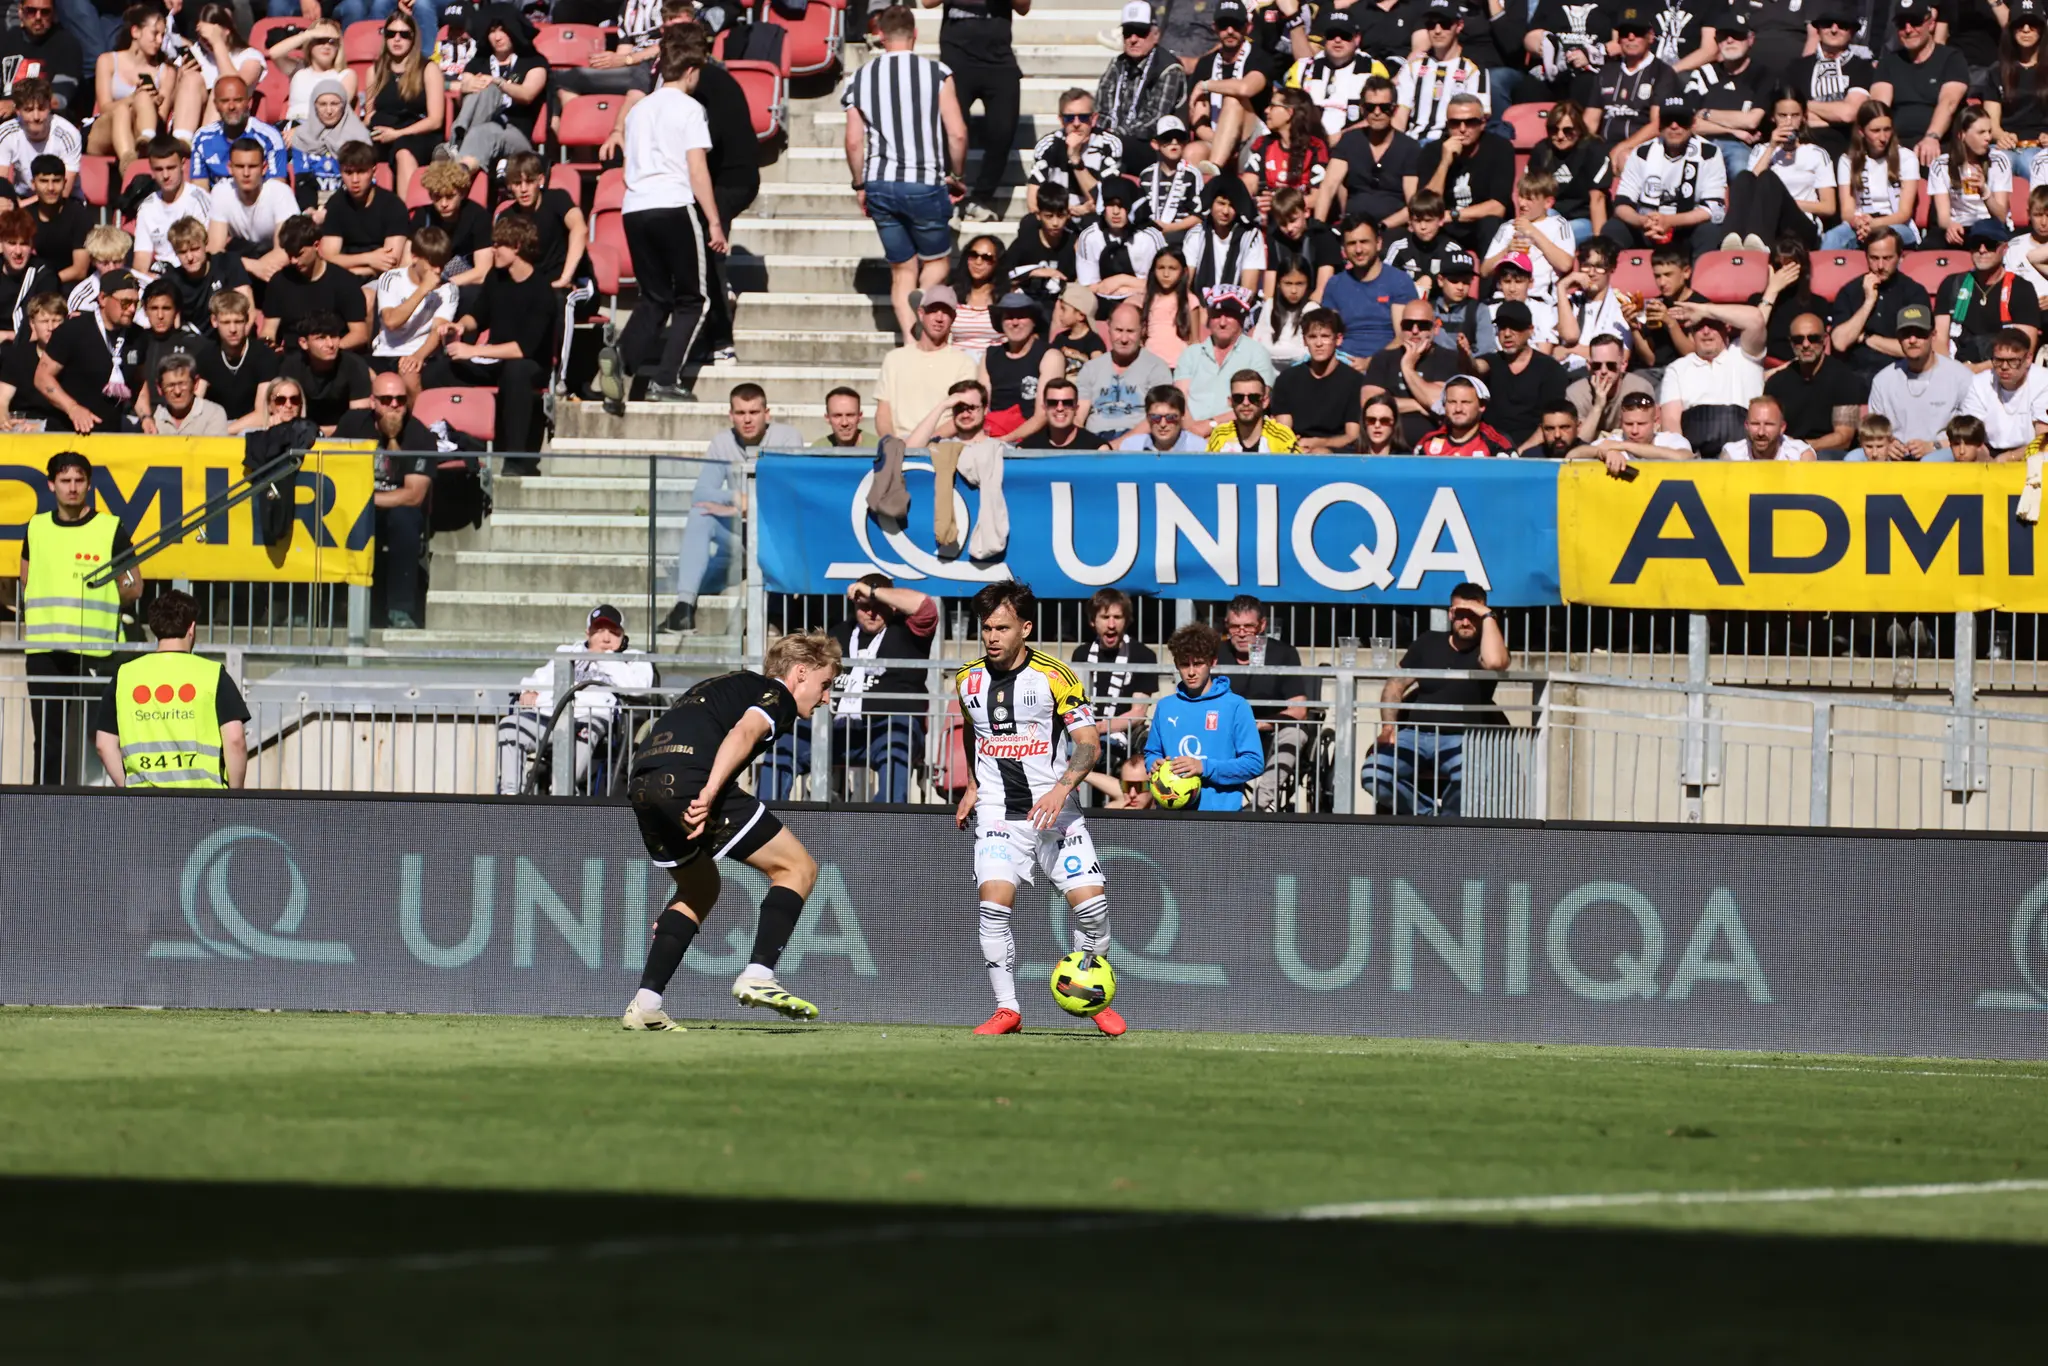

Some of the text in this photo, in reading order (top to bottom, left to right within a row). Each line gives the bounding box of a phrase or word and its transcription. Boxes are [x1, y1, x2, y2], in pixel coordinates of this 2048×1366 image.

[1050, 481, 1491, 591] UNIQA
[1609, 479, 2035, 586] ADMI
[135, 708, 195, 721] Securitas
[999, 722, 1013, 730] BWT
[990, 734, 1029, 743] backaldrin
[978, 736, 1049, 760] Kornspitz
[140, 753, 198, 769] 8417
[1056, 835, 1083, 850] BWT
[1271, 874, 1775, 1004] UNIQA
